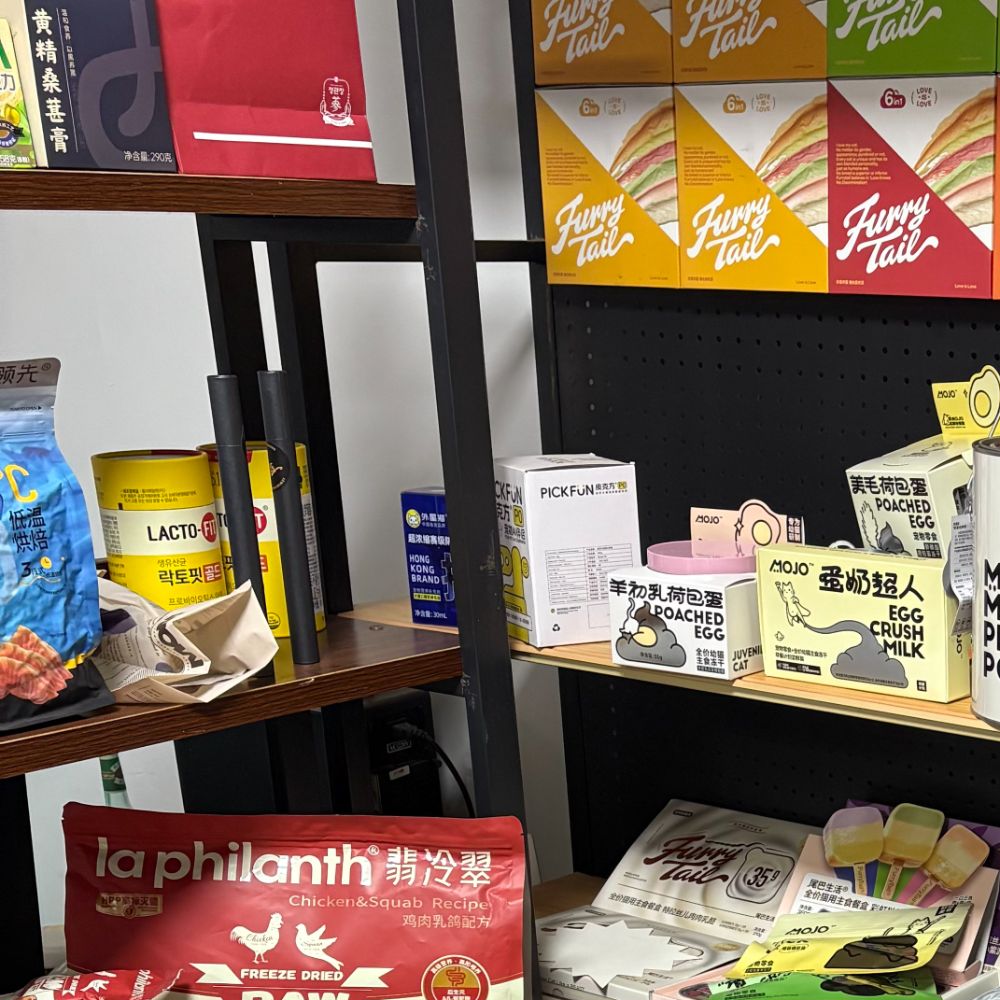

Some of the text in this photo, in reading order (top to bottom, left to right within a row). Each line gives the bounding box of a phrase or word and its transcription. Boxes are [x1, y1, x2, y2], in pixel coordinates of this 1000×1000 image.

[857, 1, 942, 51] Tail
[557, 18, 624, 63] Tail
[701, 15, 777, 59] Tail
[551, 193, 624, 255] Furry
[687, 194, 770, 258] Furry
[836, 193, 930, 260] Furry
[568, 224, 634, 266] Tail
[706, 226, 780, 270] Tail
[857, 226, 938, 274] Tail
[876, 498, 931, 513] POACHED
[9, 508, 46, 531] 低温
[696, 514, 719, 524] MOJO
[910, 516, 935, 528] EGG
[12, 529, 49, 551] 烘焙
[409, 554, 430, 563] HONG
[770, 560, 809, 576] MOJO
[411, 565, 434, 574] KONG
[412, 575, 439, 584] BRAND
[655, 606, 724, 625] POACHED
[889, 605, 923, 623] EGG
[695, 627, 725, 640] EGG
[870, 621, 923, 641] CRUSH
[884, 639, 924, 658] MILK
[733, 660, 748, 671] CAT
[643, 835, 743, 865] Furry
[386, 847, 491, 887] 翡冷翠
[660, 861, 728, 884] Tail
[747, 866, 780, 887] 35g
[289, 896, 488, 911] Chicken&Squab Recipe
[402, 914, 491, 929] 鸡肉乳鸽配方
[785, 926, 828, 935] MOJO
[241, 969, 343, 981] FREEZE DRIED
